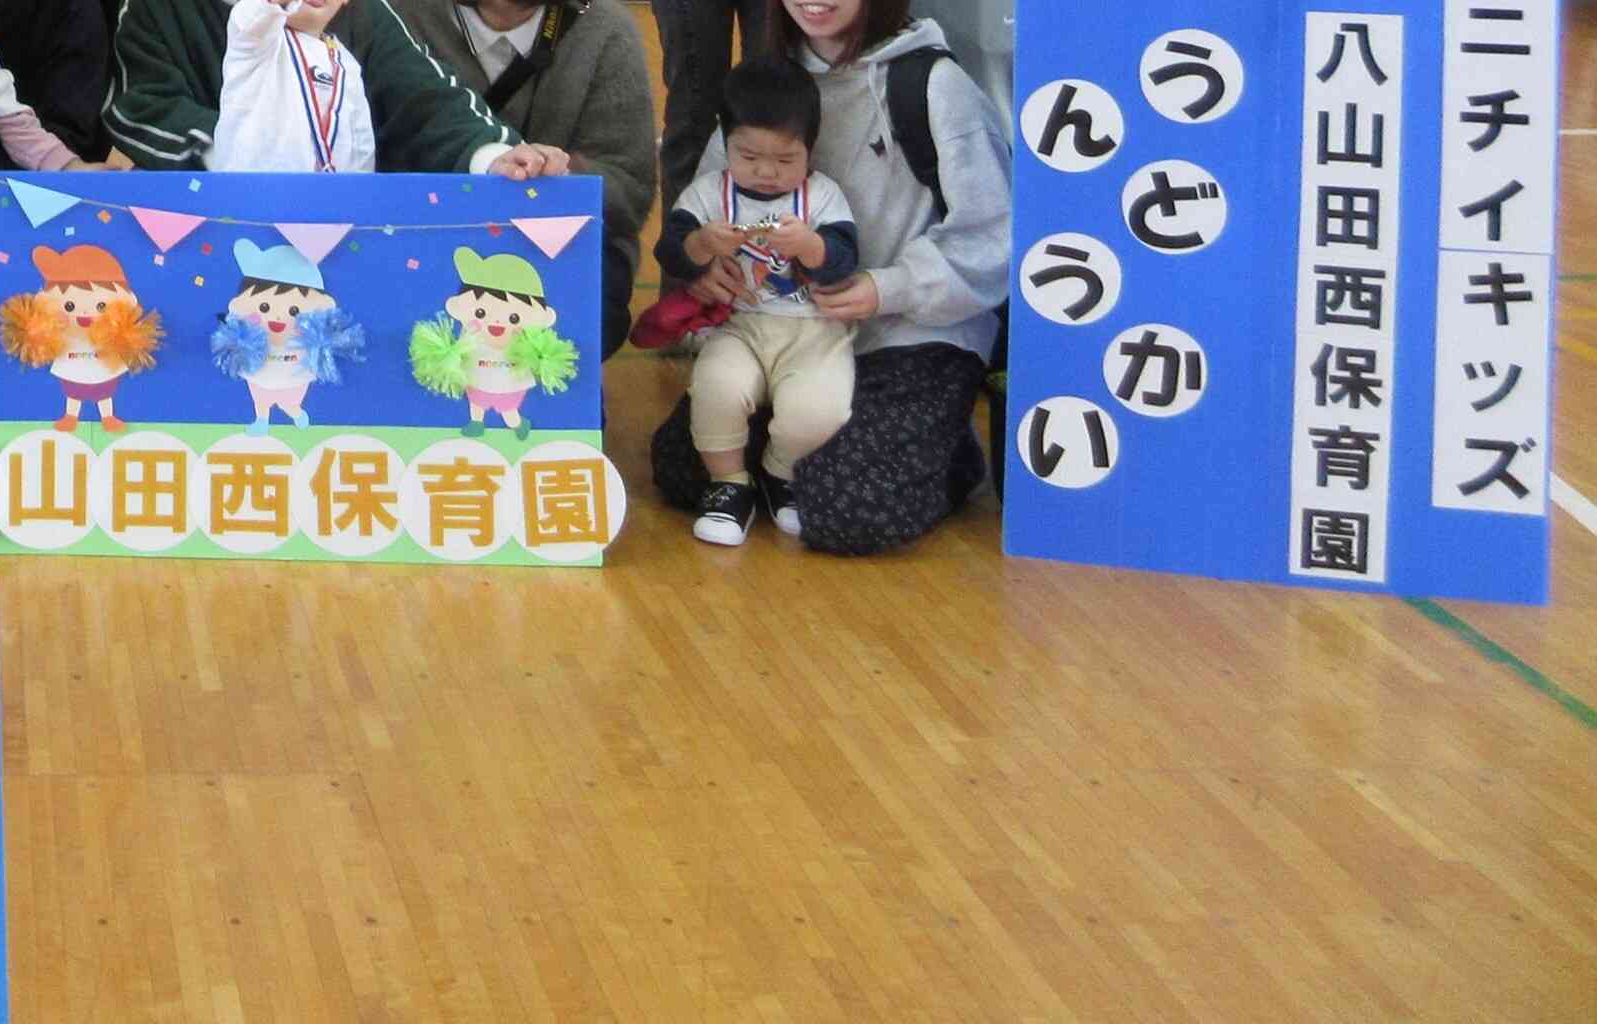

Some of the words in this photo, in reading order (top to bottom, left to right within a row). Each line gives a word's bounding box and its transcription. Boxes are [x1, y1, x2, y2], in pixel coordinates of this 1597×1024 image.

[1300, 22, 1389, 576] 八山田西保育園
